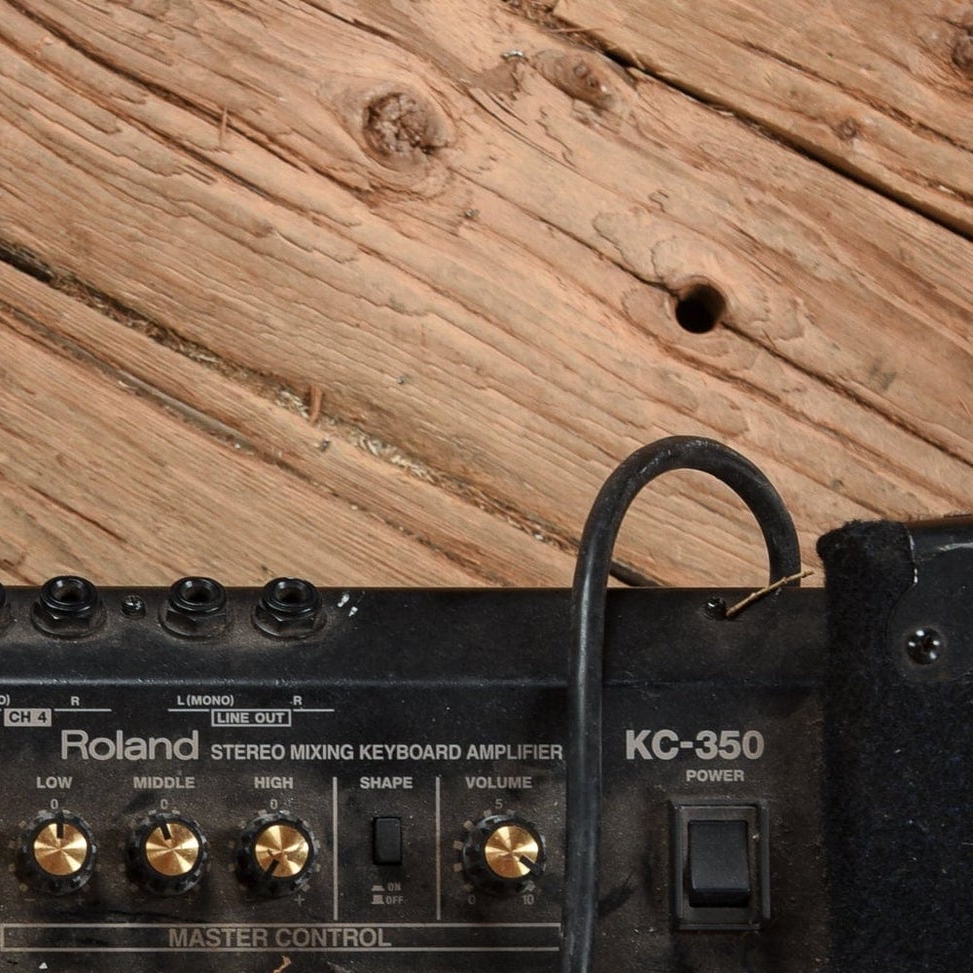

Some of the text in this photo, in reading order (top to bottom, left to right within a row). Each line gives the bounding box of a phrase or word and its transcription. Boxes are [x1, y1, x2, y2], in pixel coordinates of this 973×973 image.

[71, 697, 79, 705] R
[294, 696, 301, 705] R
[9, 711, 46, 723] CH 4
[218, 713, 284, 723] LINE OUT
[62, 730, 198, 760] Roland
[626, 729, 764, 760] KC-350
[211, 744, 562, 760] STEREO MIXING KEYBOARD AMPLIFIER
[687, 770, 744, 781] POWER
[37, 777, 72, 788] LOW
[134, 777, 195, 788] MIDDLE
[255, 777, 293, 788] HIGH
[360, 777, 412, 788] SHAPE
[466, 777, 532, 788] VOLUME
[51, 799, 58, 809] 0
[161, 799, 168, 809] 0
[496, 799, 502, 809] 5
[388, 883, 400, 891] ON
[386, 896, 403, 904] OFF
[523, 894, 534, 904] 10
[169, 928, 391, 946] MASTER CONTROL
